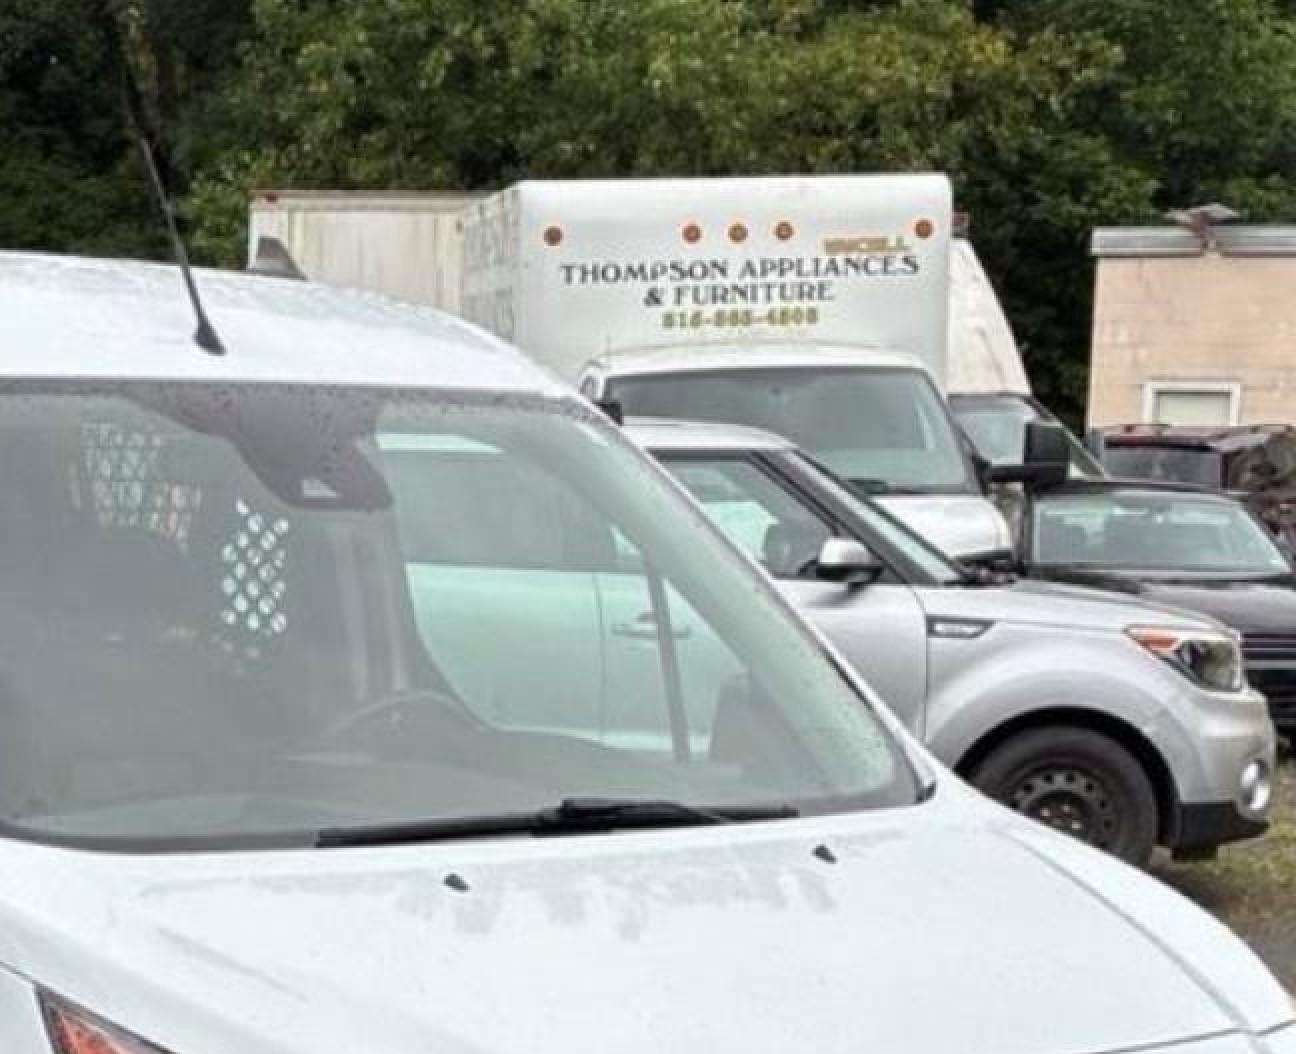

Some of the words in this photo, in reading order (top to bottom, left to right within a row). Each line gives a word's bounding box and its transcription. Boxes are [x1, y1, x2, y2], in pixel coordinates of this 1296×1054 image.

[561, 259, 728, 285] THOMPSON
[738, 255, 920, 280] APPLIANCES
[643, 287, 664, 307] &
[673, 281, 836, 305] FURNITURE
